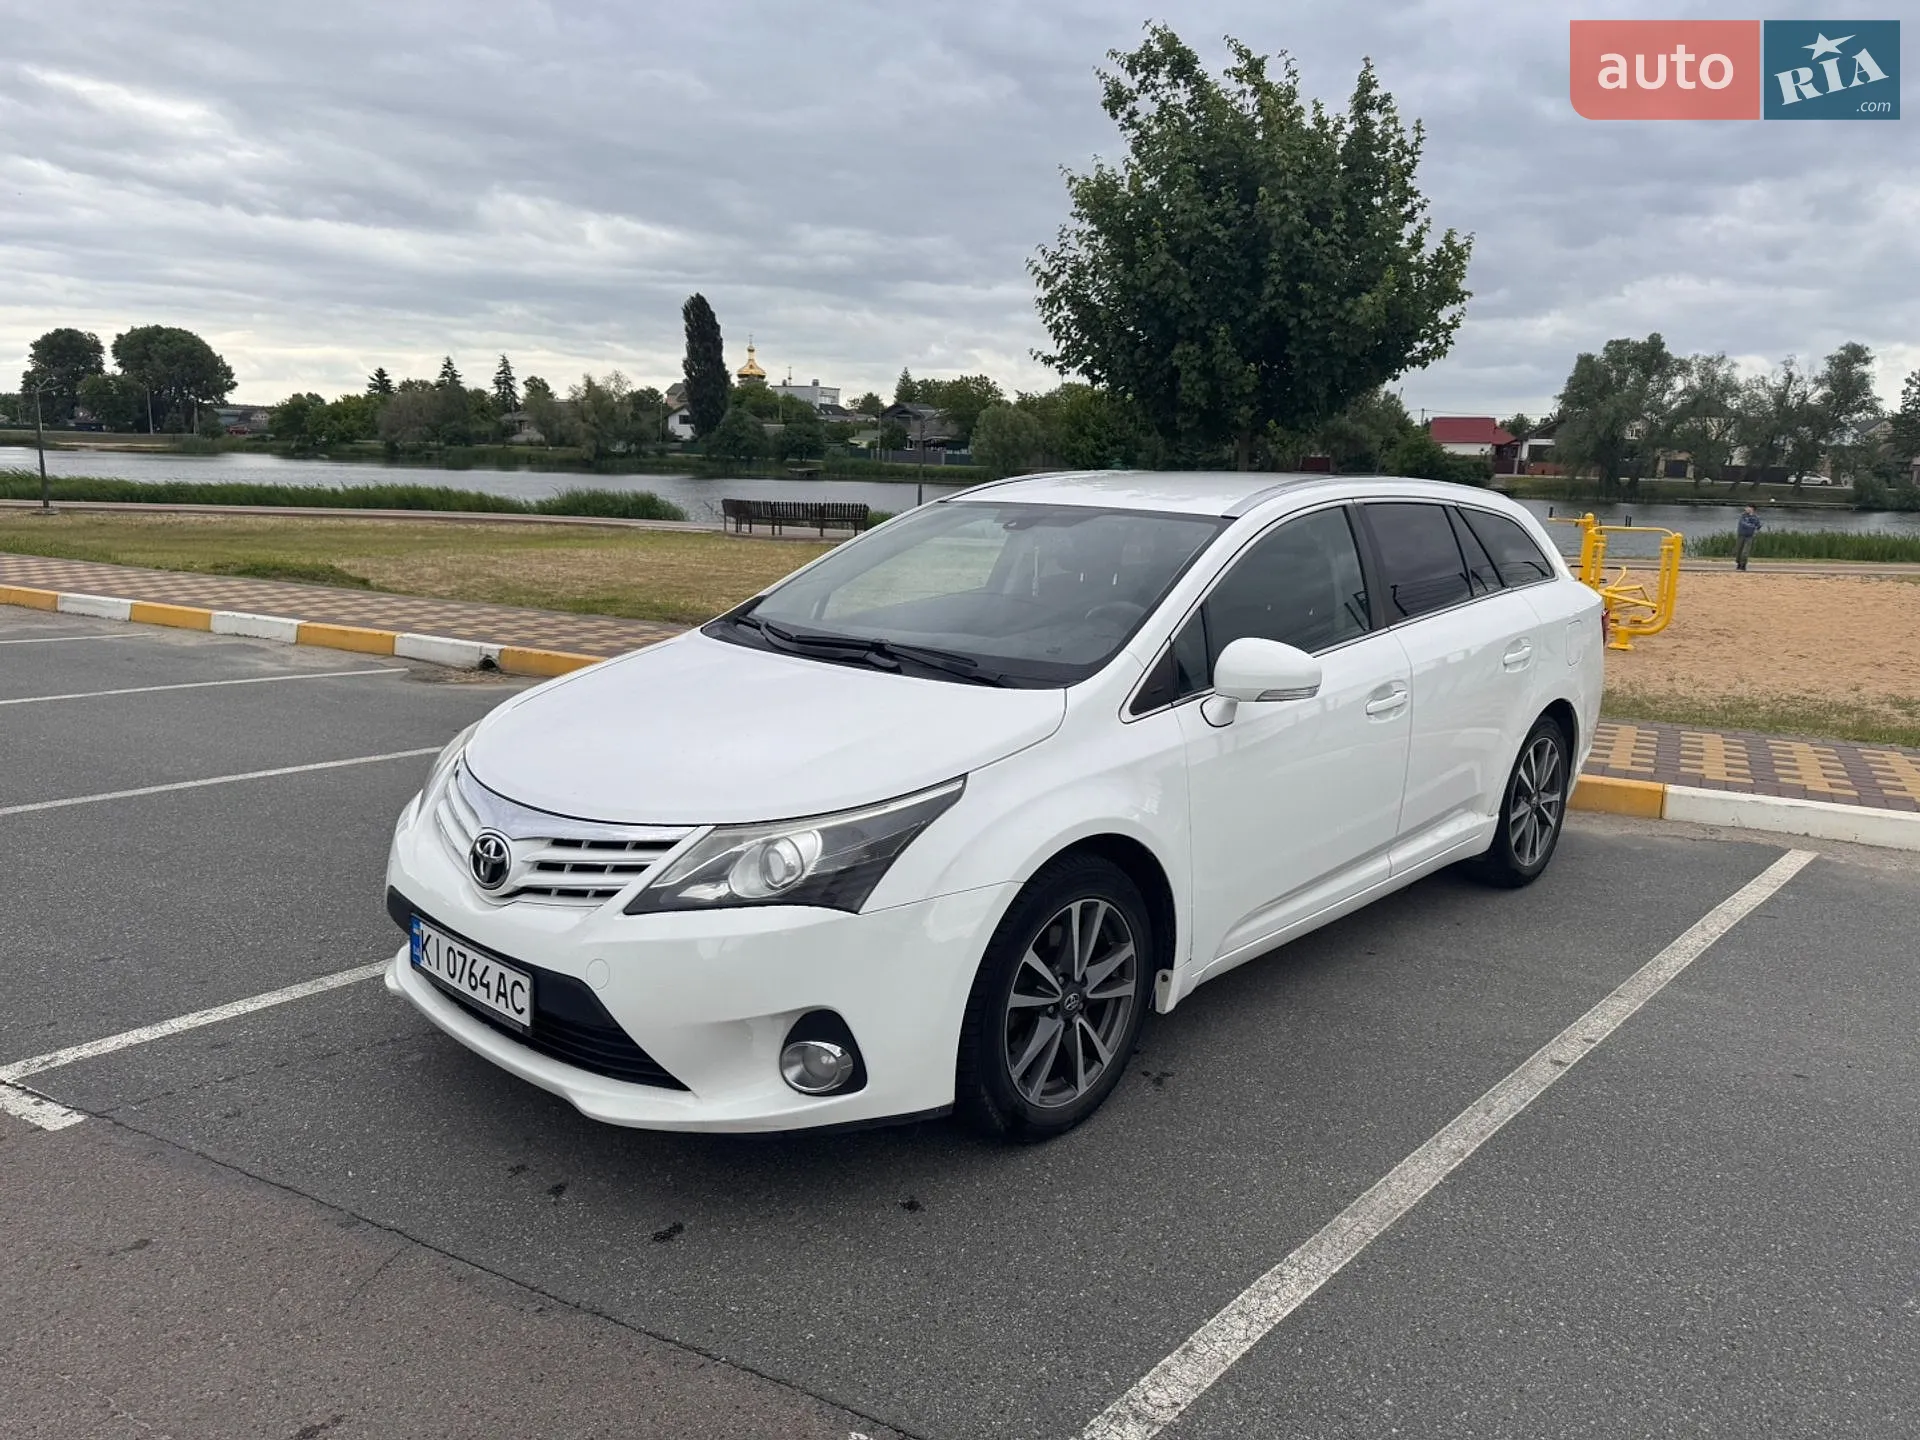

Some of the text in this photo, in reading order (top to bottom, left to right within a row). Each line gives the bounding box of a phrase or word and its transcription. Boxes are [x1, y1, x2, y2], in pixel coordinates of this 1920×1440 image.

[421, 929, 440, 970] KI
[446, 947, 491, 999] 0764
[495, 972, 526, 1015] AC
